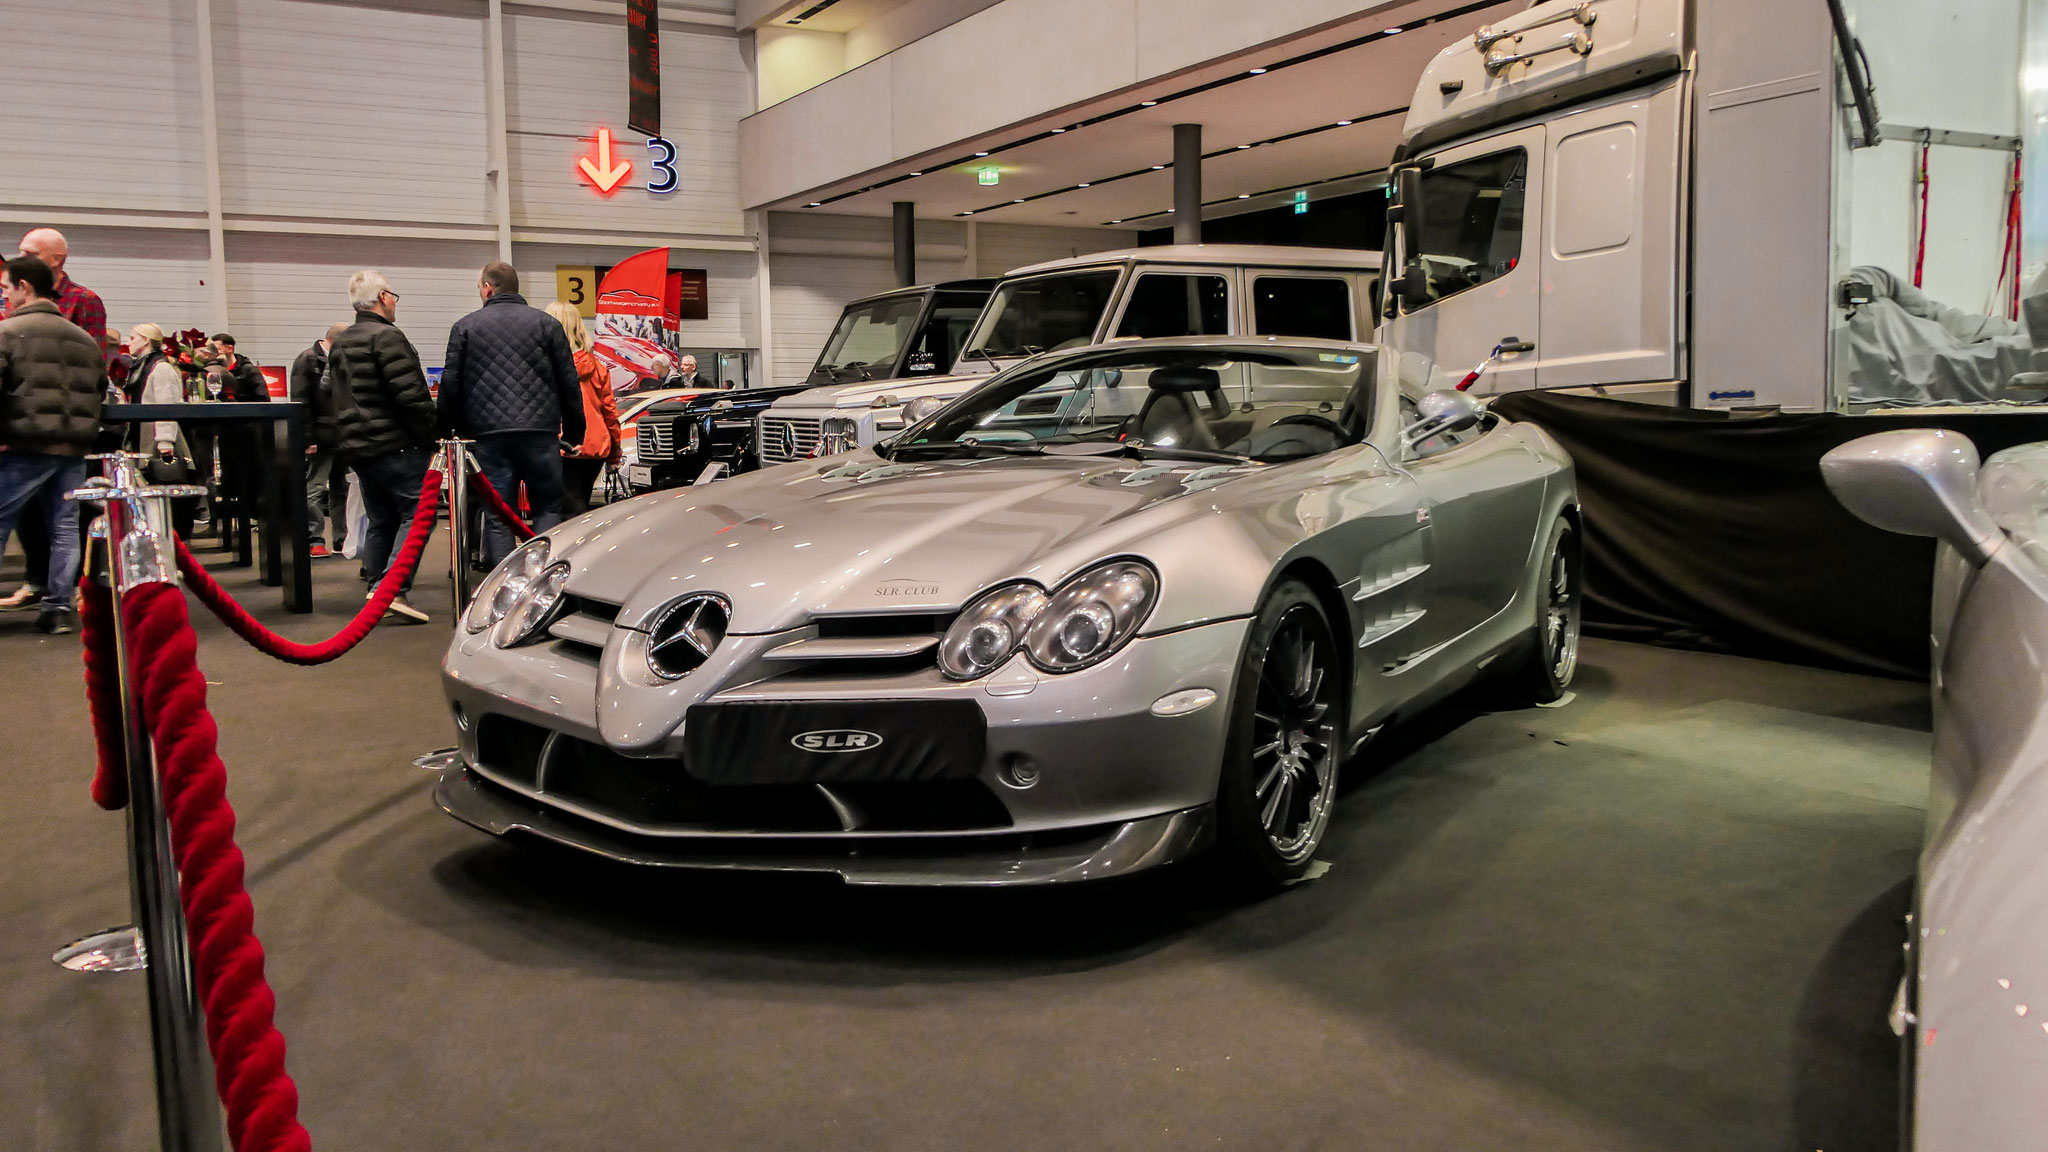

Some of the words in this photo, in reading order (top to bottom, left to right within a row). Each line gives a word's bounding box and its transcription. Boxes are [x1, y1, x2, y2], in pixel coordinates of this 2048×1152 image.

[647, 138, 679, 193] 3
[568, 276, 585, 305] 3
[874, 588, 900, 596] SLR
[904, 587, 939, 595] CLUB
[803, 734, 869, 748] SLR
